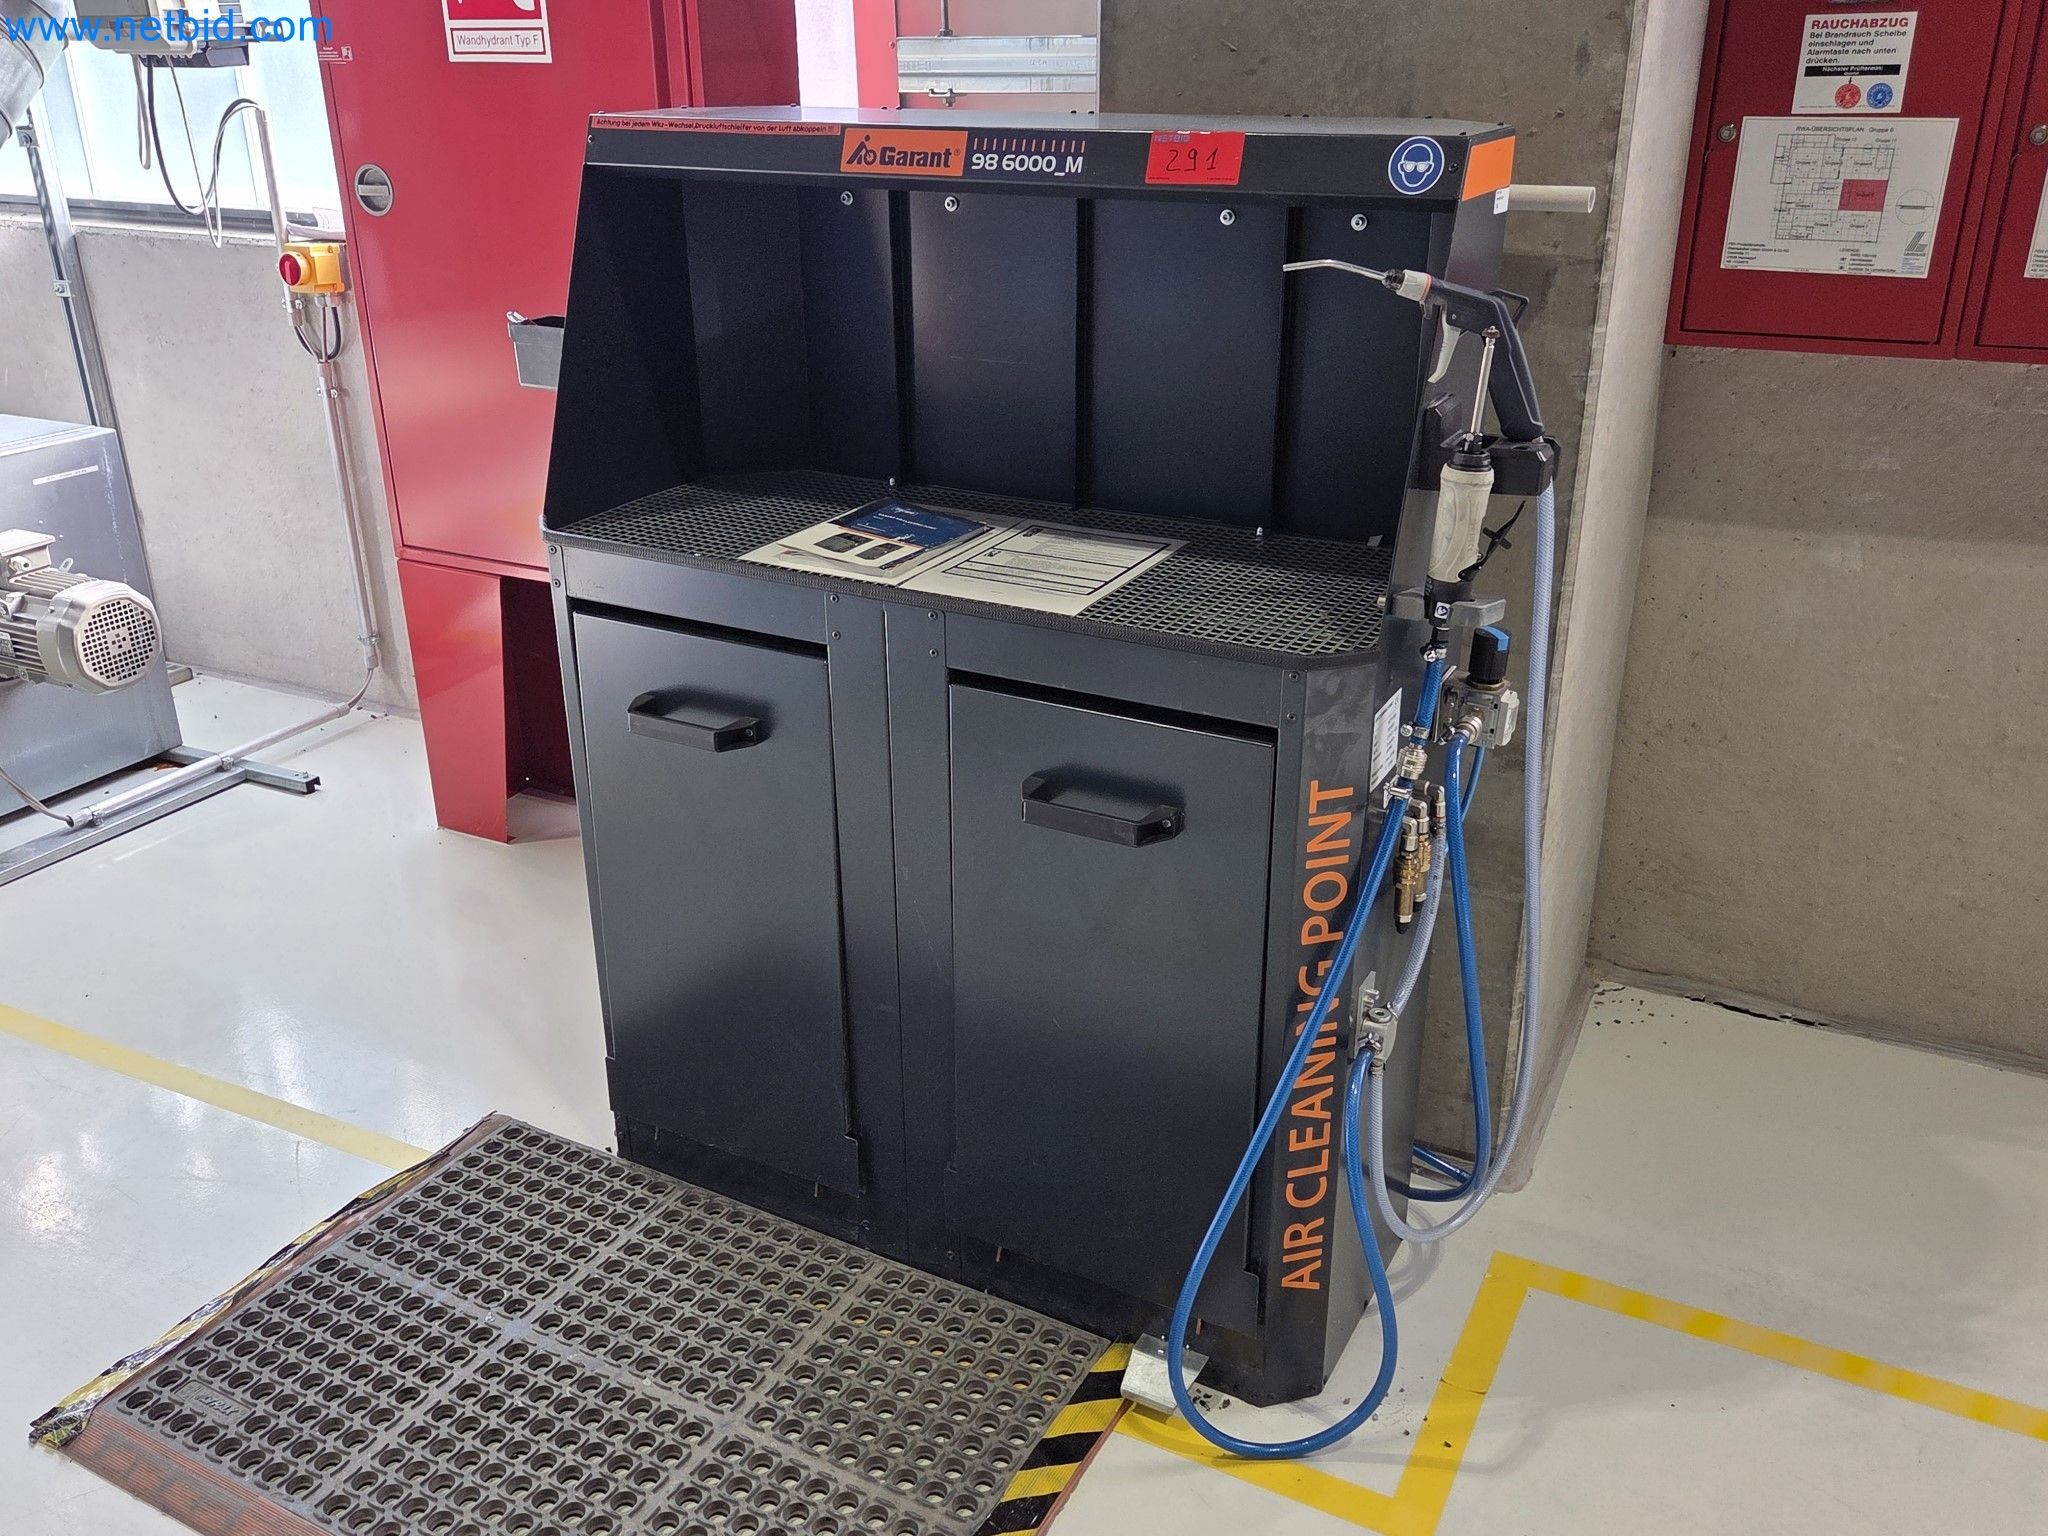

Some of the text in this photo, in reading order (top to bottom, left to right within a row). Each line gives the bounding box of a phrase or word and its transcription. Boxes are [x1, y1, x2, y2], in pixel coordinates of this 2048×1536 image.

[1811, 17, 1909, 30] RAUCHABZUG
[456, 34, 539, 47] Wandhydrant Typ F
[1809, 29, 1907, 39] Bei Brandrauch Scheibe
[1807, 40, 1857, 48] einschlagen
[1806, 46, 1897, 56] Alarmtaste nach unten
[1805, 56, 1840, 64] drücken.
[596, 119, 621, 128] Achtung
[631, 121, 651, 129] jedem
[792, 125, 827, 134] abkoppeln
[879, 146, 1084, 177] Garant 98 6000_M
[1166, 147, 1219, 172] 291
[1301, 780, 1354, 945] POINT
[1281, 1216, 1323, 1290] AIR
